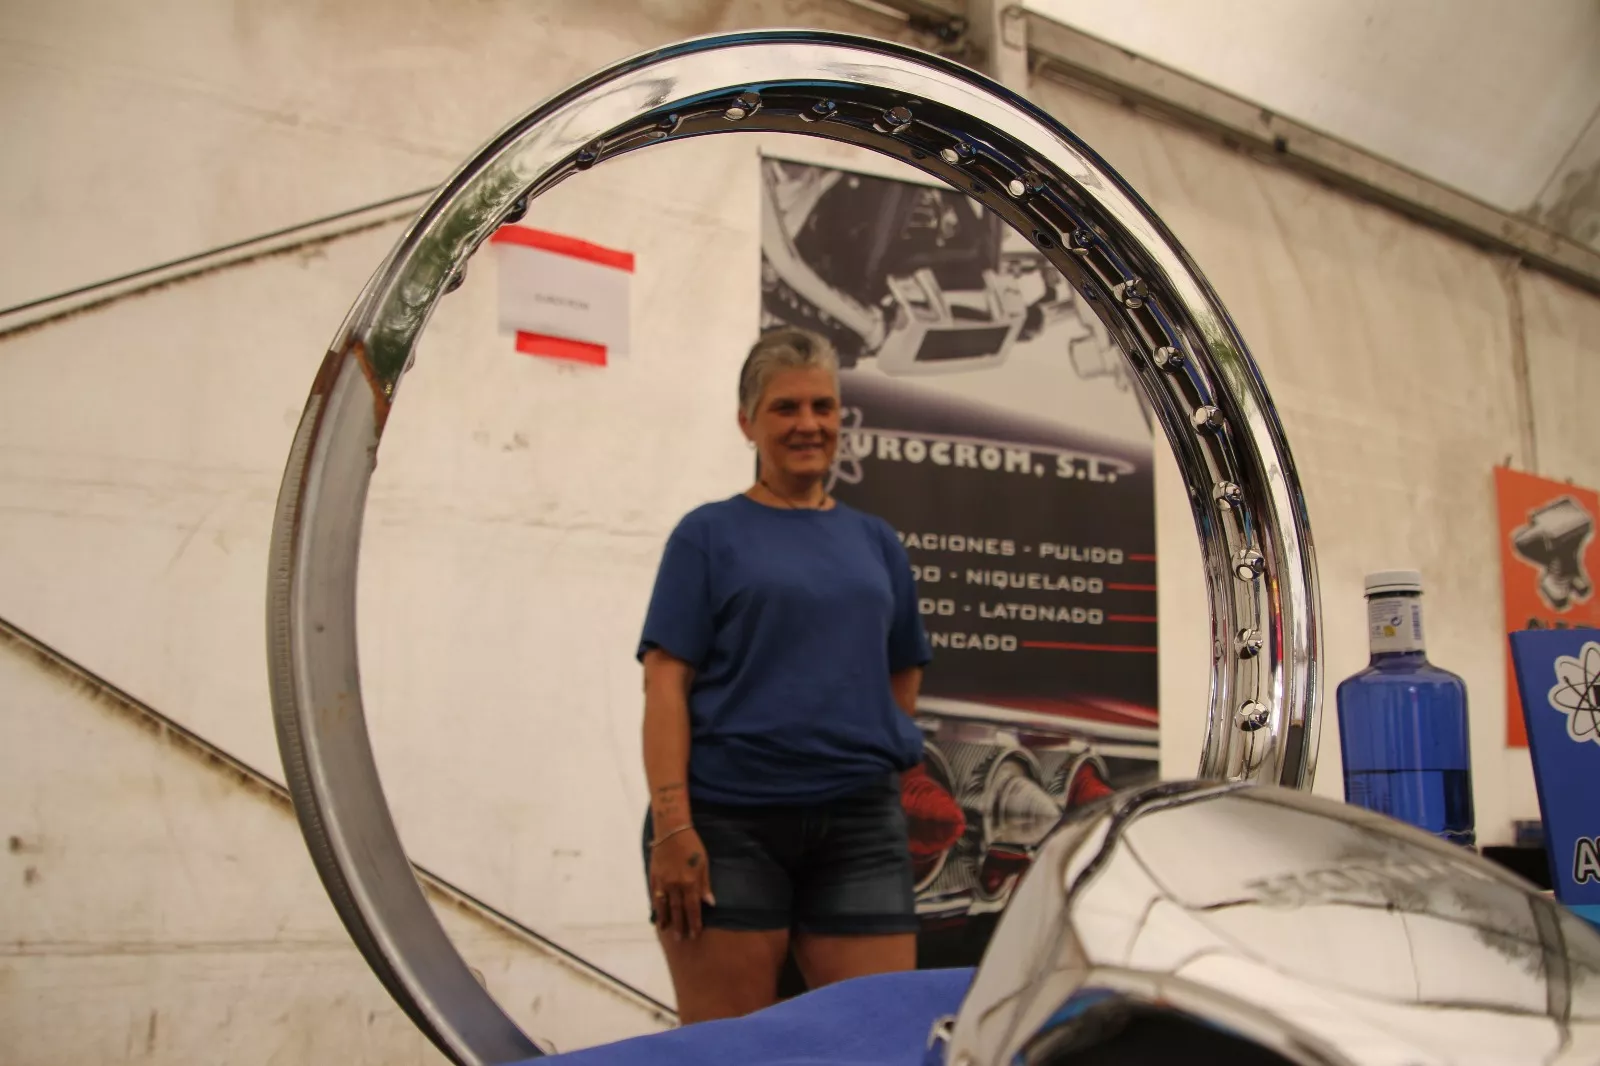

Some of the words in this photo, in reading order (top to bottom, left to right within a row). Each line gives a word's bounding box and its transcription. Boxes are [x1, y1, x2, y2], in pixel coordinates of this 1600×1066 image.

[1056, 453, 1118, 484] S.L.
[1039, 542, 1124, 565] PULIDO
[966, 568, 1104, 594] NIQUELADO
[979, 601, 1104, 625] LATONADO
[925, 631, 1017, 651] NCADO
